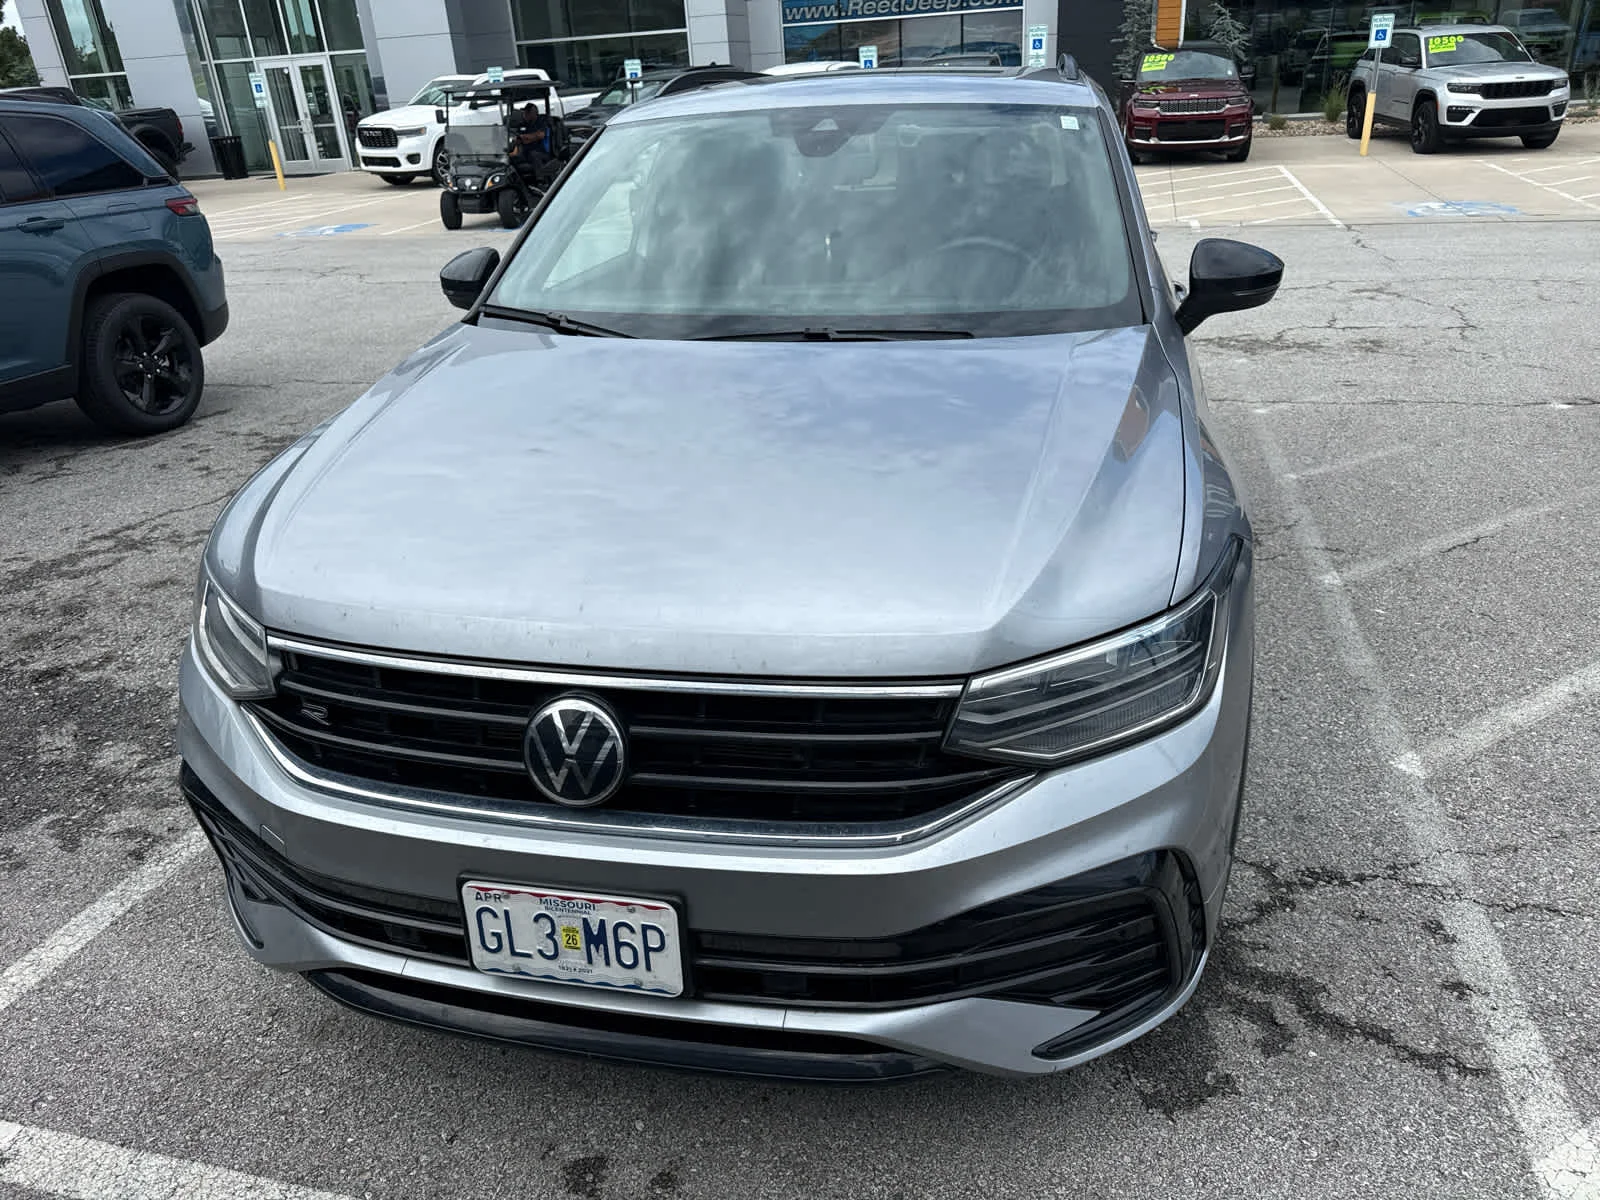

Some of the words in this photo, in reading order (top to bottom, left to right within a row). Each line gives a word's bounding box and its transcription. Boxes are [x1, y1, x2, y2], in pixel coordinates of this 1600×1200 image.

[785, 0, 1022, 20] www.ReedJeep.c
[475, 891, 503, 902] APR
[539, 898, 596, 911] MISSOURI
[475, 906, 560, 961] GL3
[582, 916, 666, 972] M6P
[565, 933, 578, 946] 26
